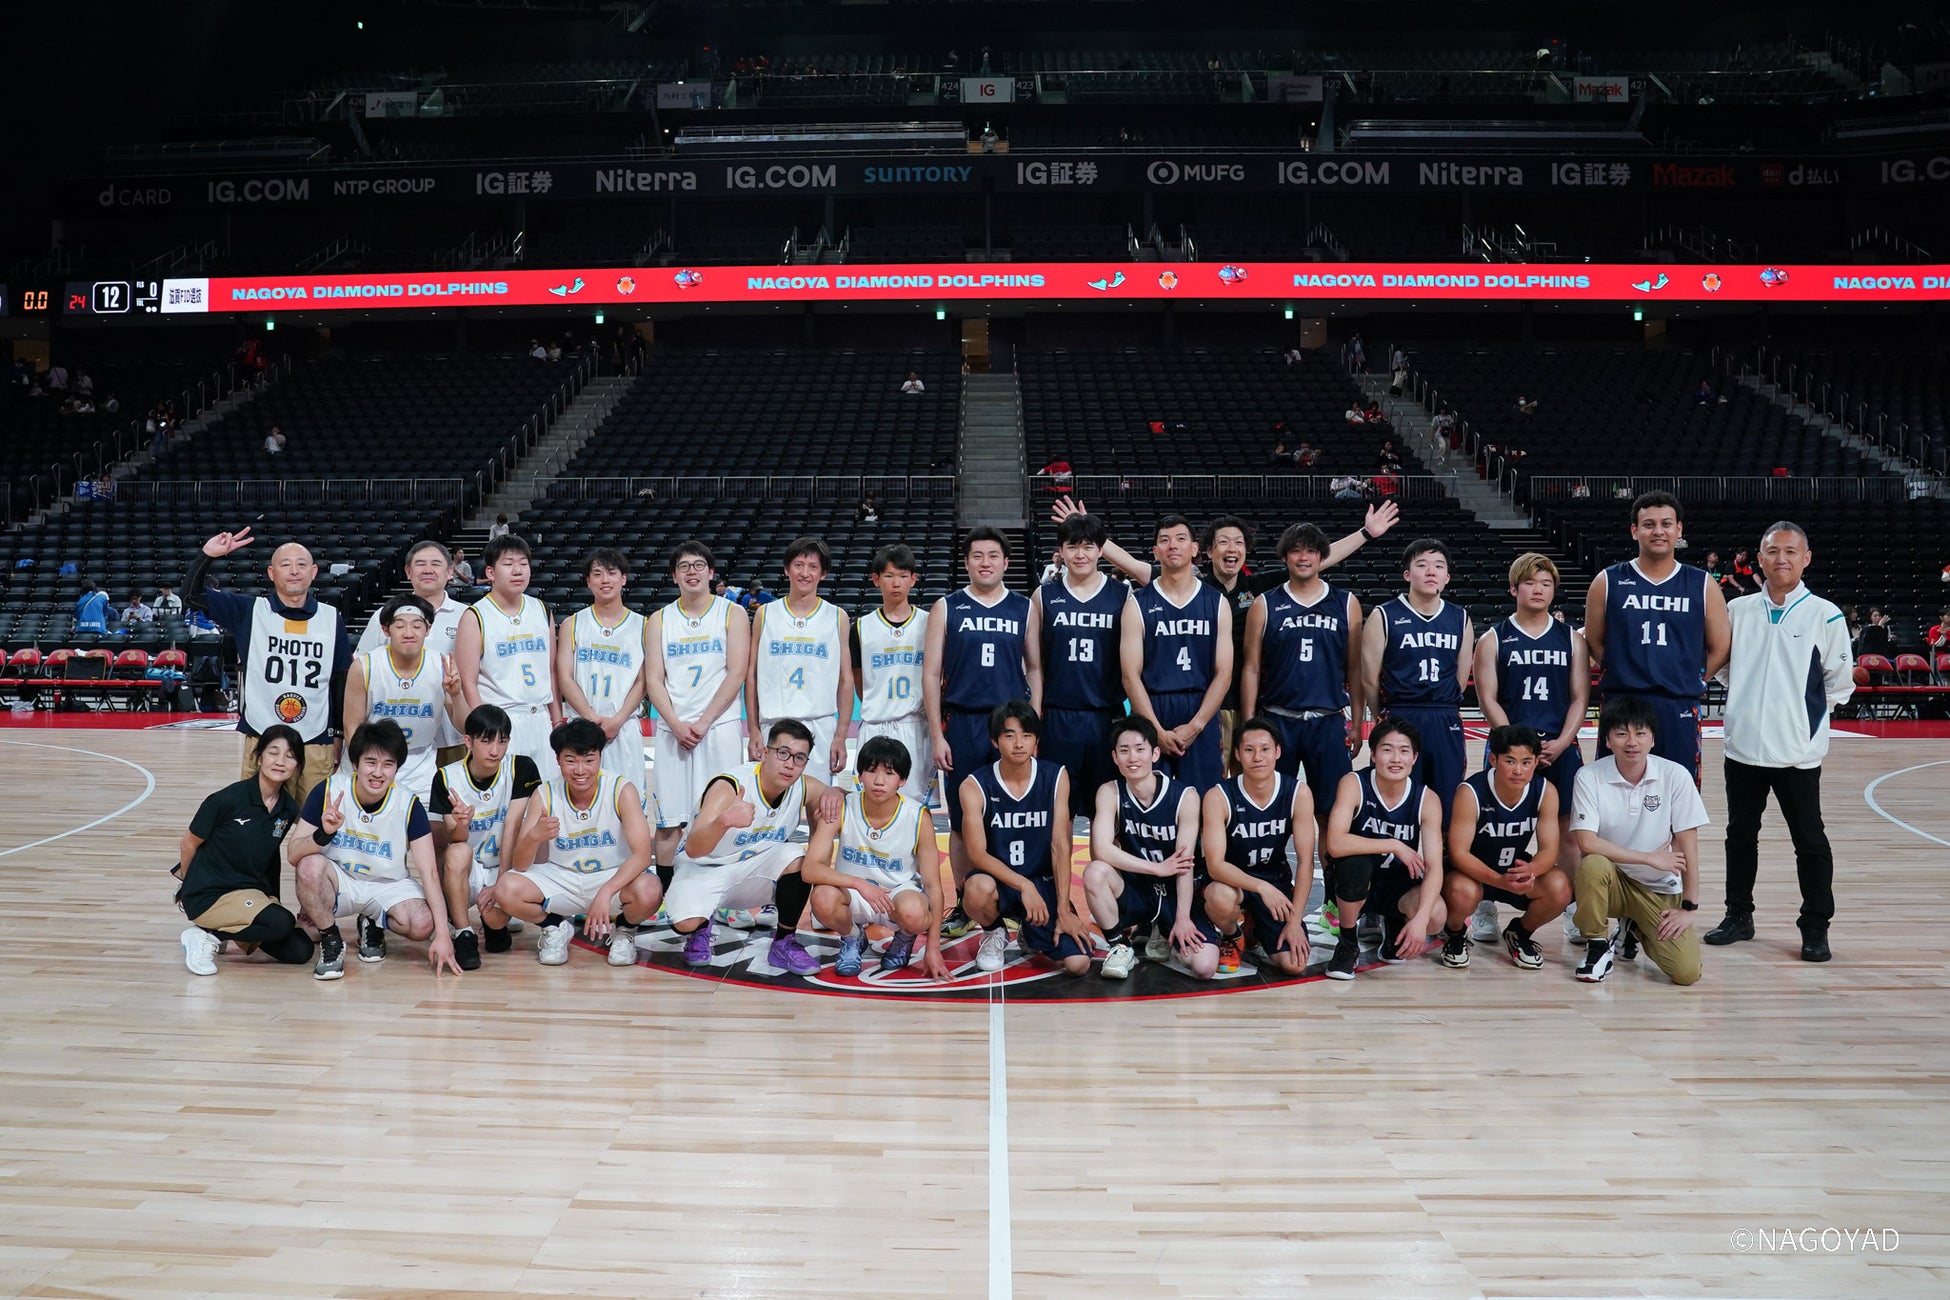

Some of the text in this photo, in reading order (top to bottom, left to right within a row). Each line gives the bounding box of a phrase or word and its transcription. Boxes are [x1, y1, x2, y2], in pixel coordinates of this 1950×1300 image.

[941, 82, 959, 90] 424
[980, 84, 996, 96] IG
[1016, 81, 1034, 90] 423
[476, 170, 553, 195] IG証券
[596, 168, 697, 193] Niterra
[726, 164, 837, 189] IG.COM
[1017, 160, 1099, 186] IG証券
[1184, 164, 1245, 182] MUFG
[1278, 161, 1390, 186] IG.COM
[1419, 162, 1524, 187] Niterra
[1551, 161, 1632, 187] IG証券
[1653, 162, 1737, 188] Mazak
[119, 189, 172, 206] CARD
[207, 178, 310, 202] IG.COM
[333, 177, 436, 196] NTP GROUP
[232, 281, 509, 300] NAGOYA DIAMOND DOLPHINS
[747, 273, 1046, 290] NAGOYA DIAMOND DOLPHINS
[1293, 273, 1591, 288] NAGOYA DIAMOND DOLPHINS
[1833, 276, 1917, 291] NAGOYA
[23, 291, 49, 310] 0.0
[69, 294, 87, 310] 24
[102, 286, 120, 308] 12
[1621, 593, 1690, 613] AICHI
[958, 616, 1019, 636] AICHI
[1052, 610, 1114, 630] AICHI
[1154, 618, 1211, 637] AICHI
[1278, 612, 1339, 632] AICHI
[1400, 631, 1458, 651] AICHI
[1640, 620, 1668, 647] 11
[268, 635, 323, 659] PHOTO
[495, 636, 547, 658] SHIGA
[577, 646, 633, 670] SHIGA
[666, 638, 724, 659] SHIGA
[768, 639, 829, 660] SHIGA
[870, 648, 924, 670] SHIGA
[980, 643, 995, 668] 6
[1067, 637, 1094, 663] 13
[1175, 646, 1193, 672] 4
[1299, 637, 1314, 663] 5
[1506, 649, 1568, 667] AICHI
[264, 655, 322, 689] 012
[521, 662, 536, 688] 5
[687, 664, 704, 689] 7
[787, 666, 805, 691] 4
[1418, 657, 1441, 683] 15
[589, 672, 613, 698] 11
[886, 674, 912, 700] 10
[1521, 676, 1549, 701] 14
[372, 701, 433, 718] SHIGA
[991, 810, 1048, 830] AICHI
[1125, 818, 1176, 842] AICHI
[1361, 814, 1416, 841] AICHI
[1478, 816, 1538, 838] AICHI
[555, 828, 617, 852] SHIGA
[841, 845, 904, 873] SHIGA
[1009, 839, 1025, 867] 8
[1498, 847, 1516, 868] 9
